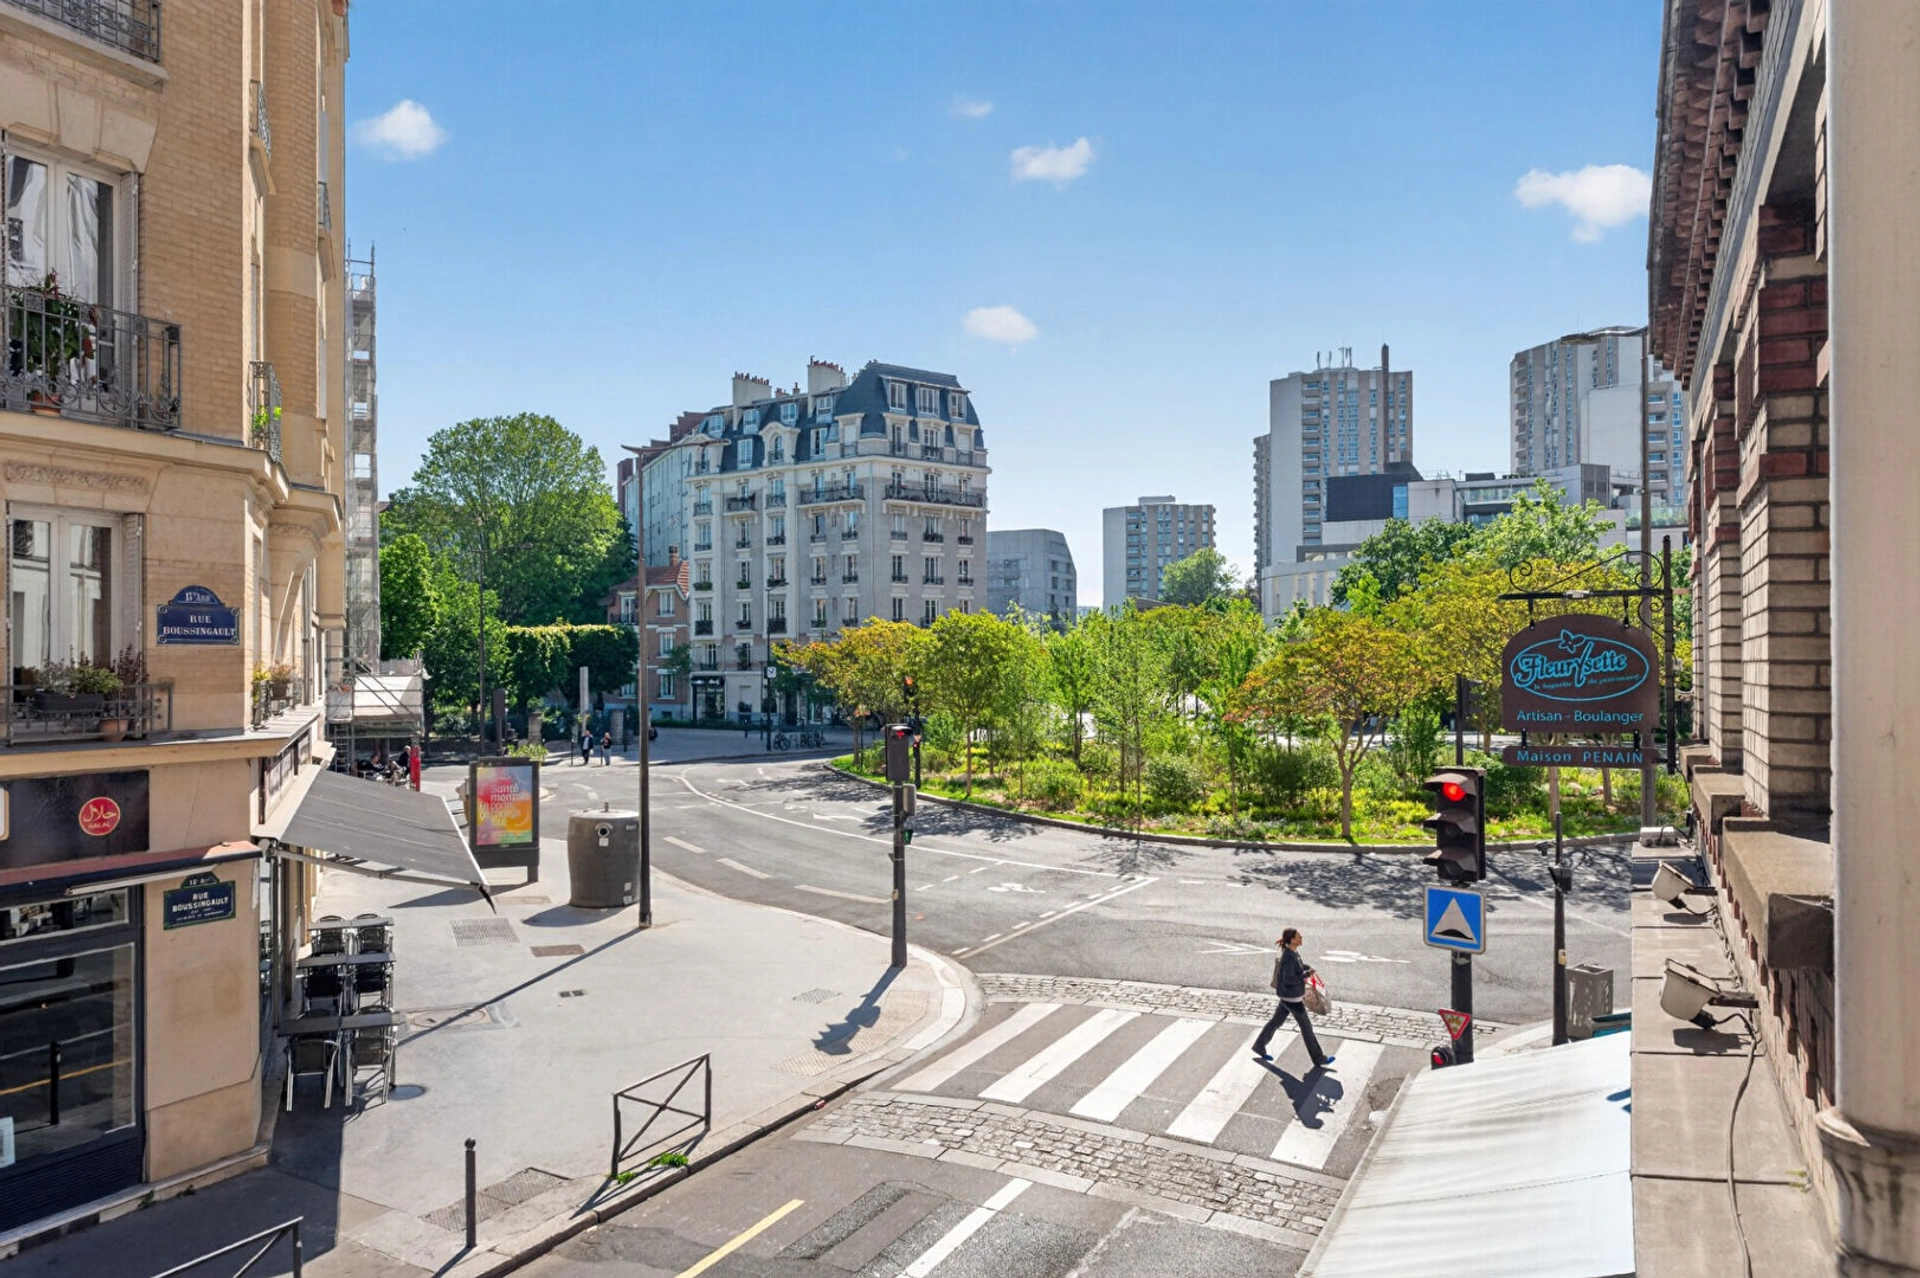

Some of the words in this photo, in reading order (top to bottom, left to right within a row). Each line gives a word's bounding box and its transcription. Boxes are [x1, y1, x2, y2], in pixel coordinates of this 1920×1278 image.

[190, 615, 211, 624] RUE
[163, 626, 235, 636] BOUSSINGAULT
[1517, 710, 1562, 721] Artisan
[1574, 710, 1643, 725] Boulanger
[1516, 751, 1571, 762] Maison
[1583, 751, 1643, 763] PENAIN
[192, 892, 209, 900] RUE
[172, 897, 229, 913] BOUSSINGAULT
